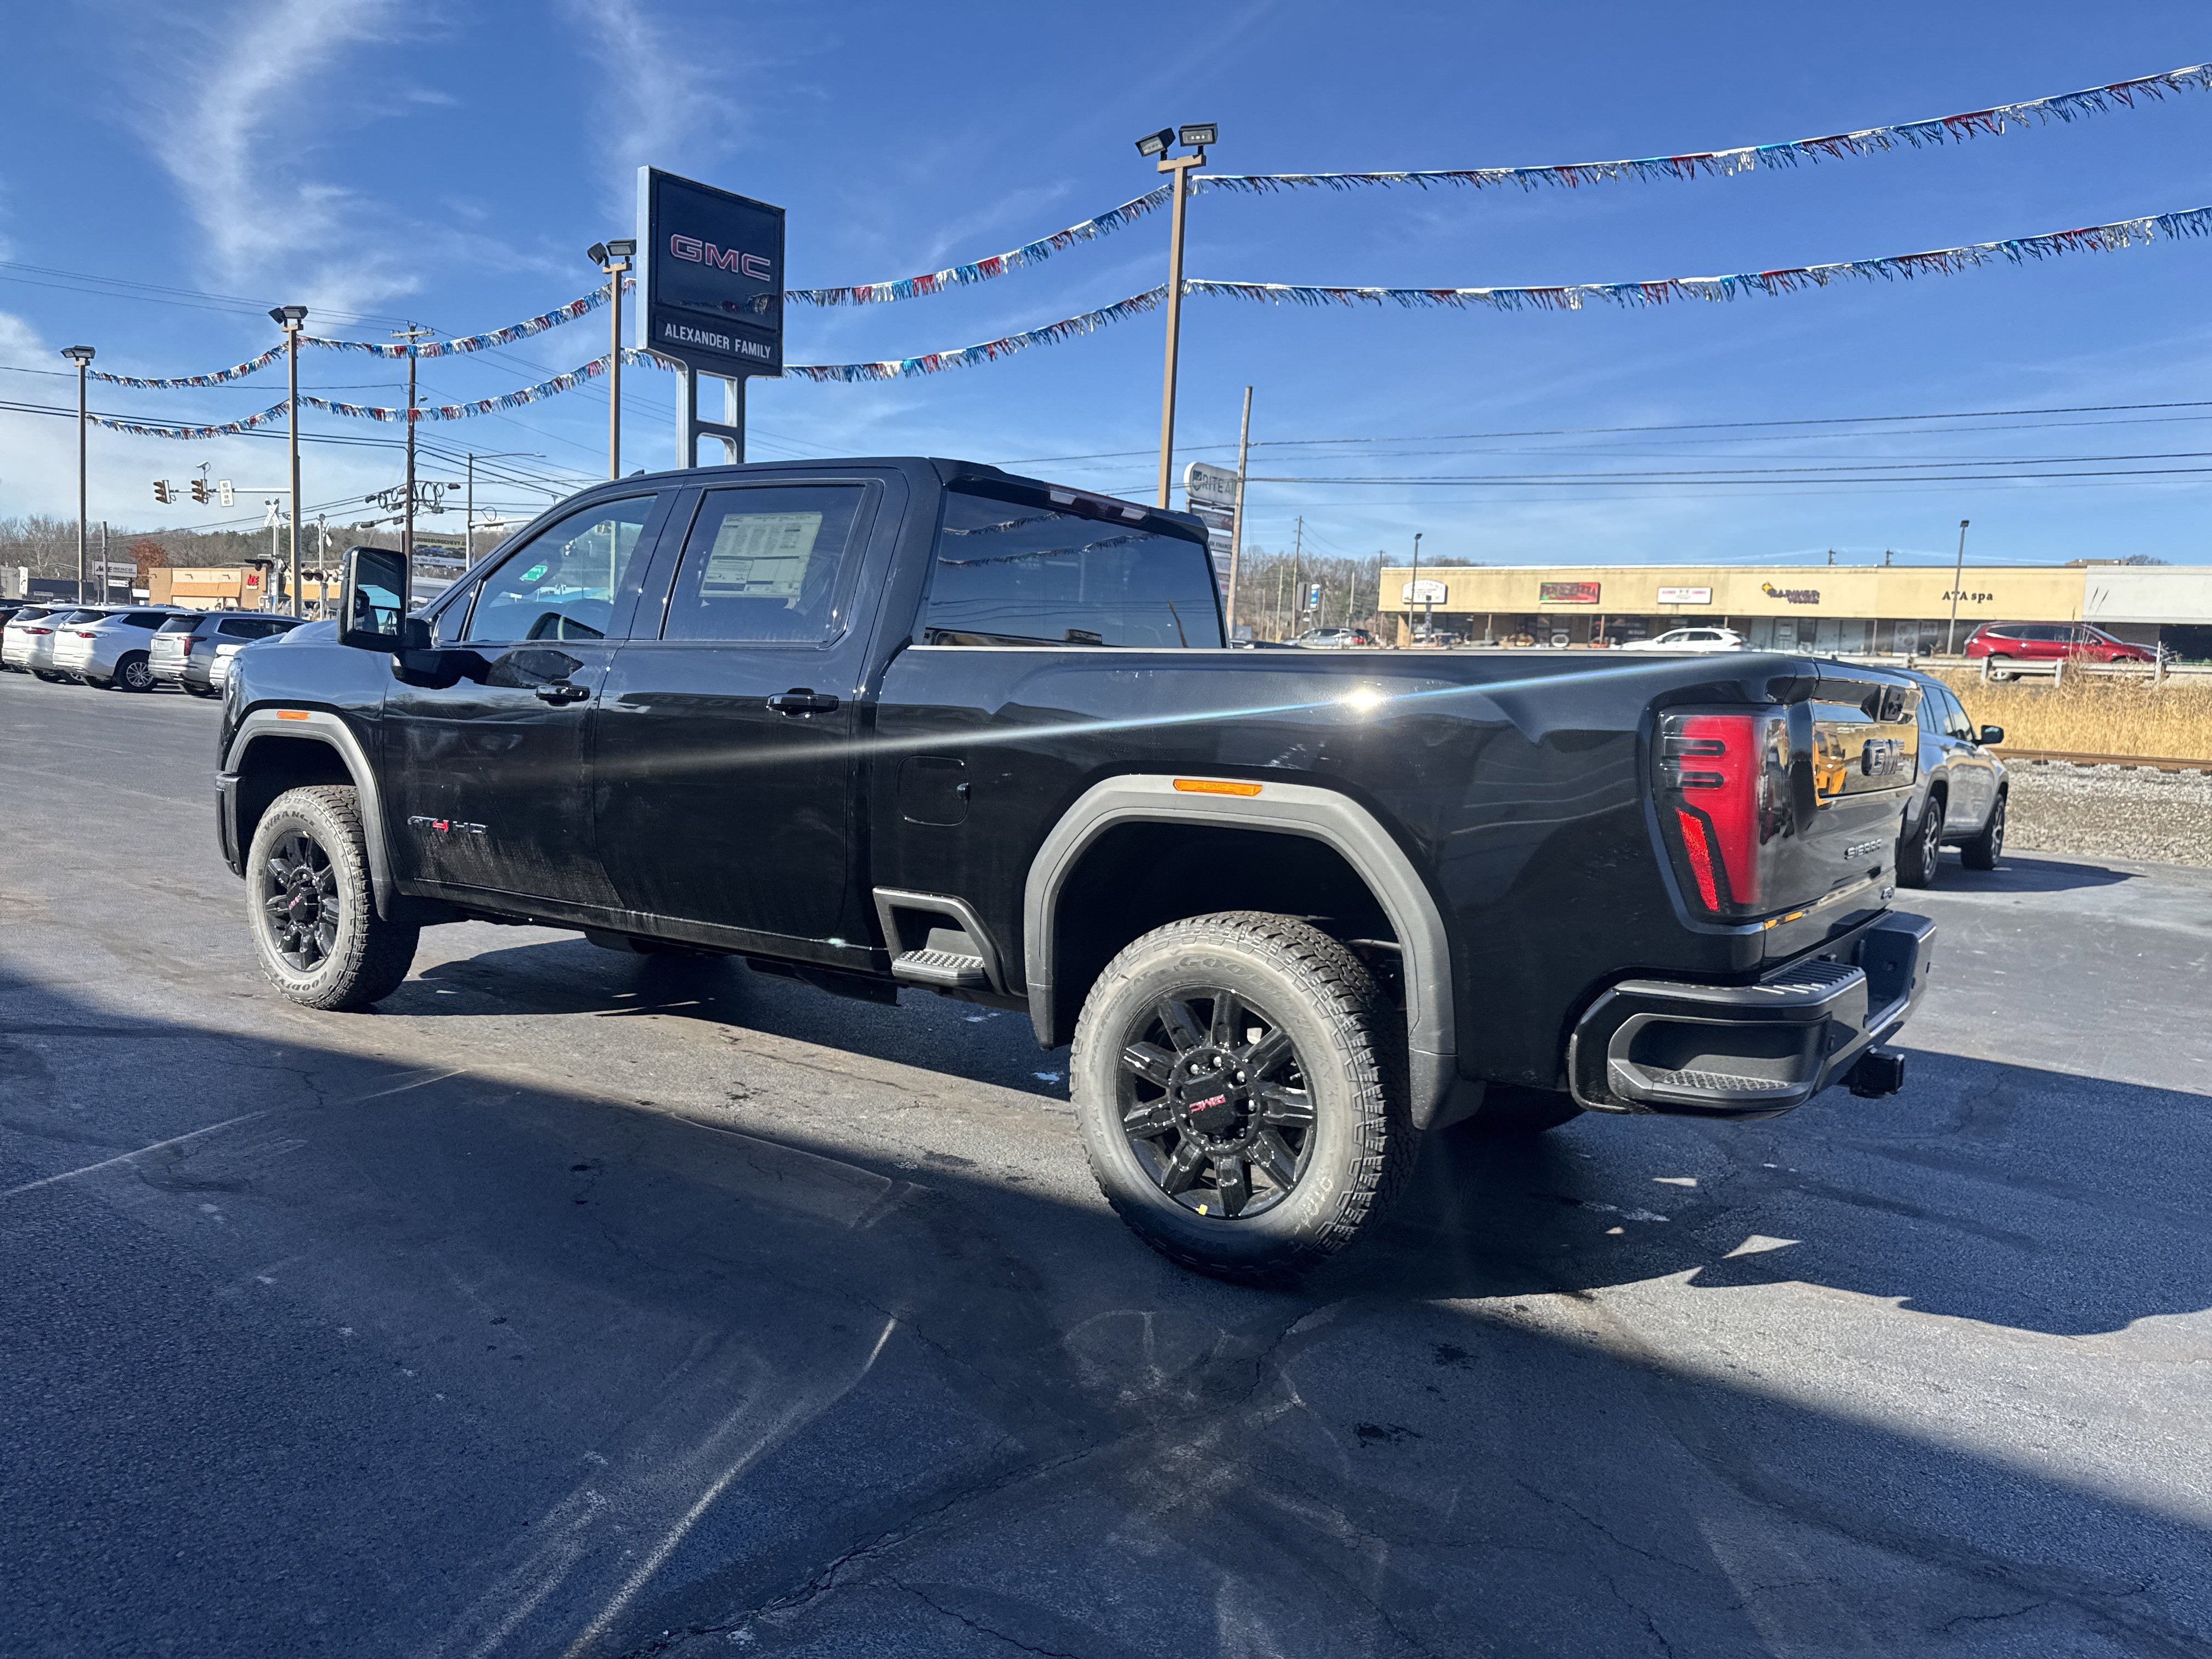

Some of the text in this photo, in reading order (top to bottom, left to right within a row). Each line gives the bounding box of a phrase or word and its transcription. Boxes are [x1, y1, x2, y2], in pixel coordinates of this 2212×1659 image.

[671, 233, 770, 281] GMC
[664, 323, 771, 359] ALEXANDER FAMILY
[1203, 473, 1223, 493] RITE
[1971, 592, 1993, 604] spa
